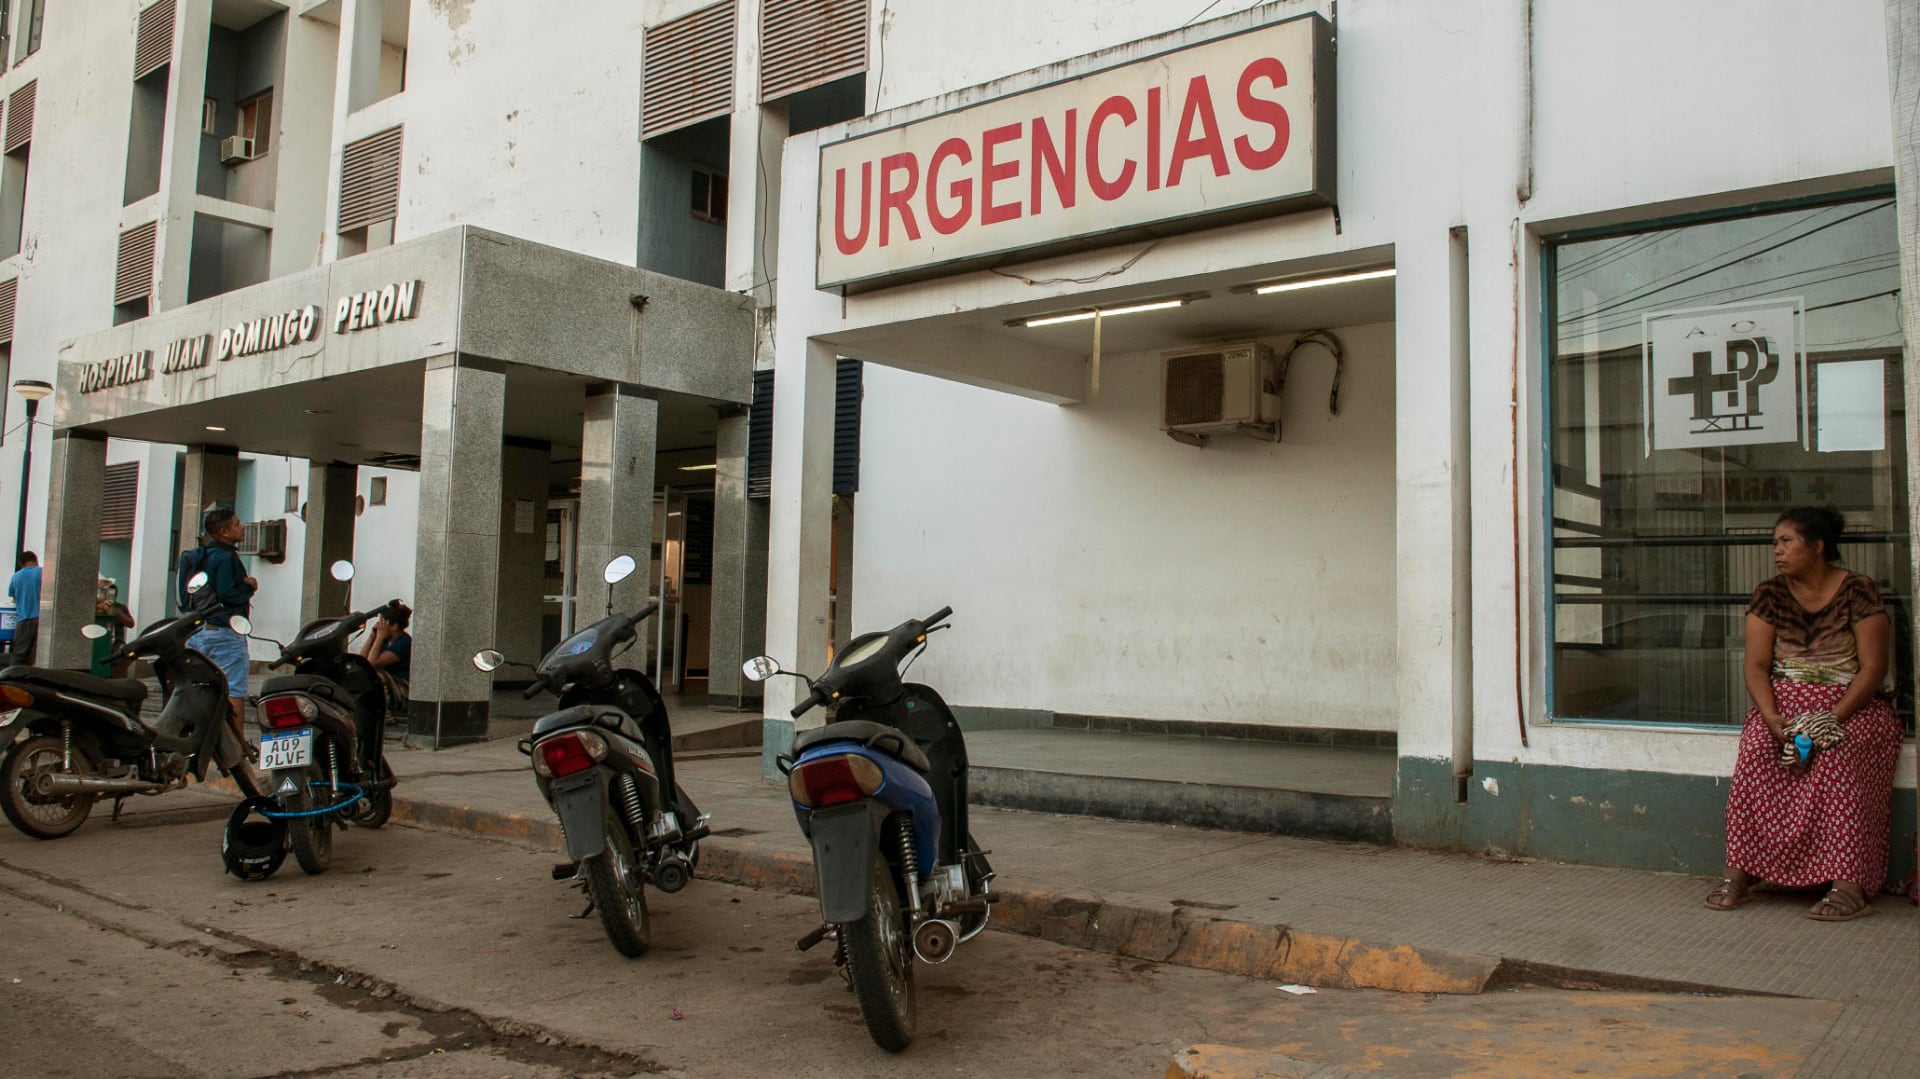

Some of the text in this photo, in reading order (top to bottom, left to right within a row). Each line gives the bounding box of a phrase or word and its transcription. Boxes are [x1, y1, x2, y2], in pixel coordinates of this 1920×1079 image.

[834, 57, 1291, 256] URGENCIAS
[80, 279, 422, 394] HOSPITAL JUAN DOMINGO PERON
[265, 750, 305, 767] 9LVF
[270, 738, 300, 754] A09
